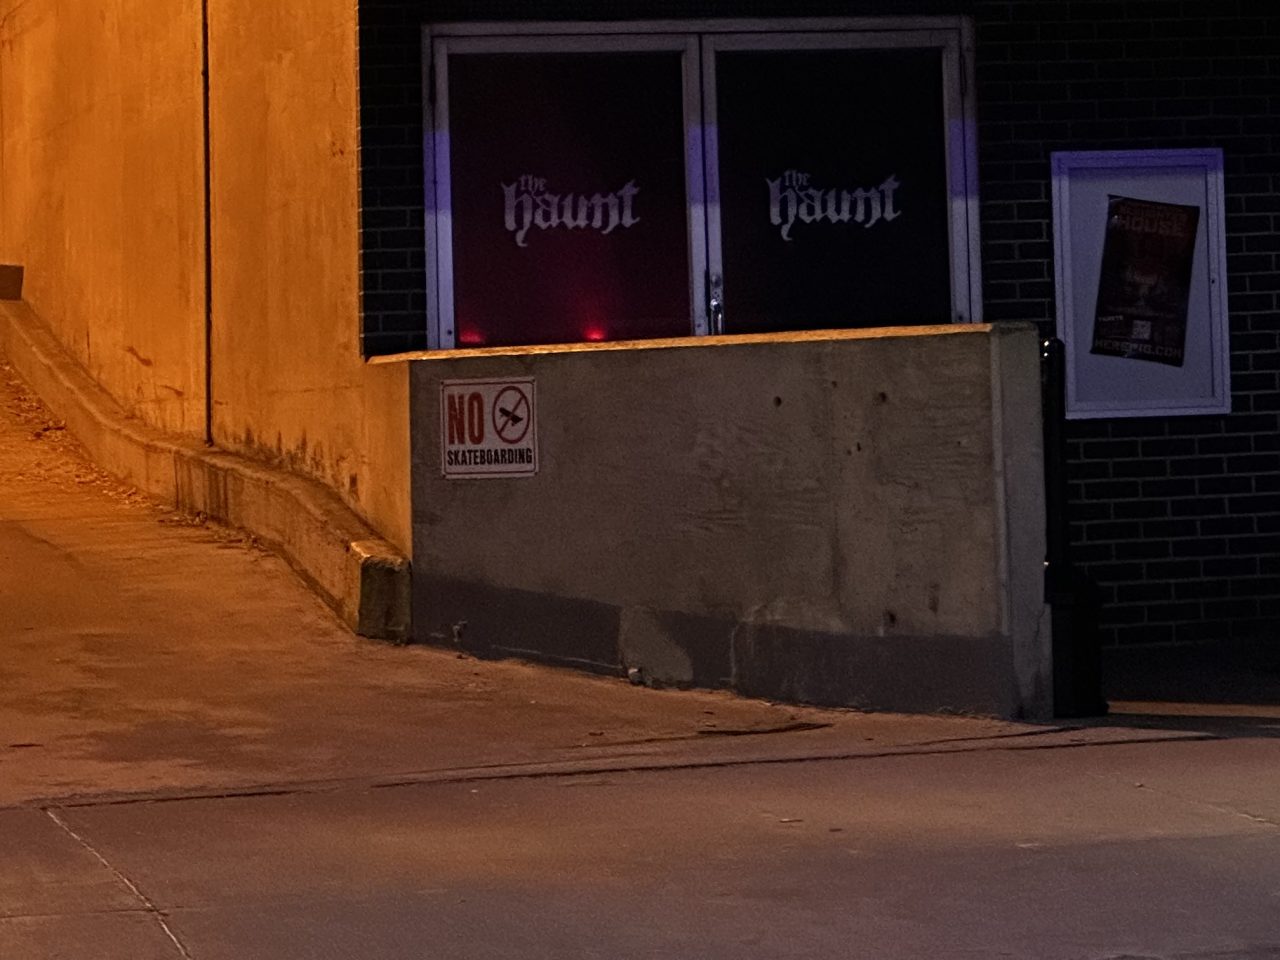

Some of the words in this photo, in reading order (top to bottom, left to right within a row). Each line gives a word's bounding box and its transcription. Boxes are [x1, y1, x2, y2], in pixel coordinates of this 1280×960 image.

[500, 178, 640, 247] haunt
[764, 172, 902, 240] haunt
[447, 392, 484, 445] NO
[447, 448, 532, 466] SKATEBOARDING
